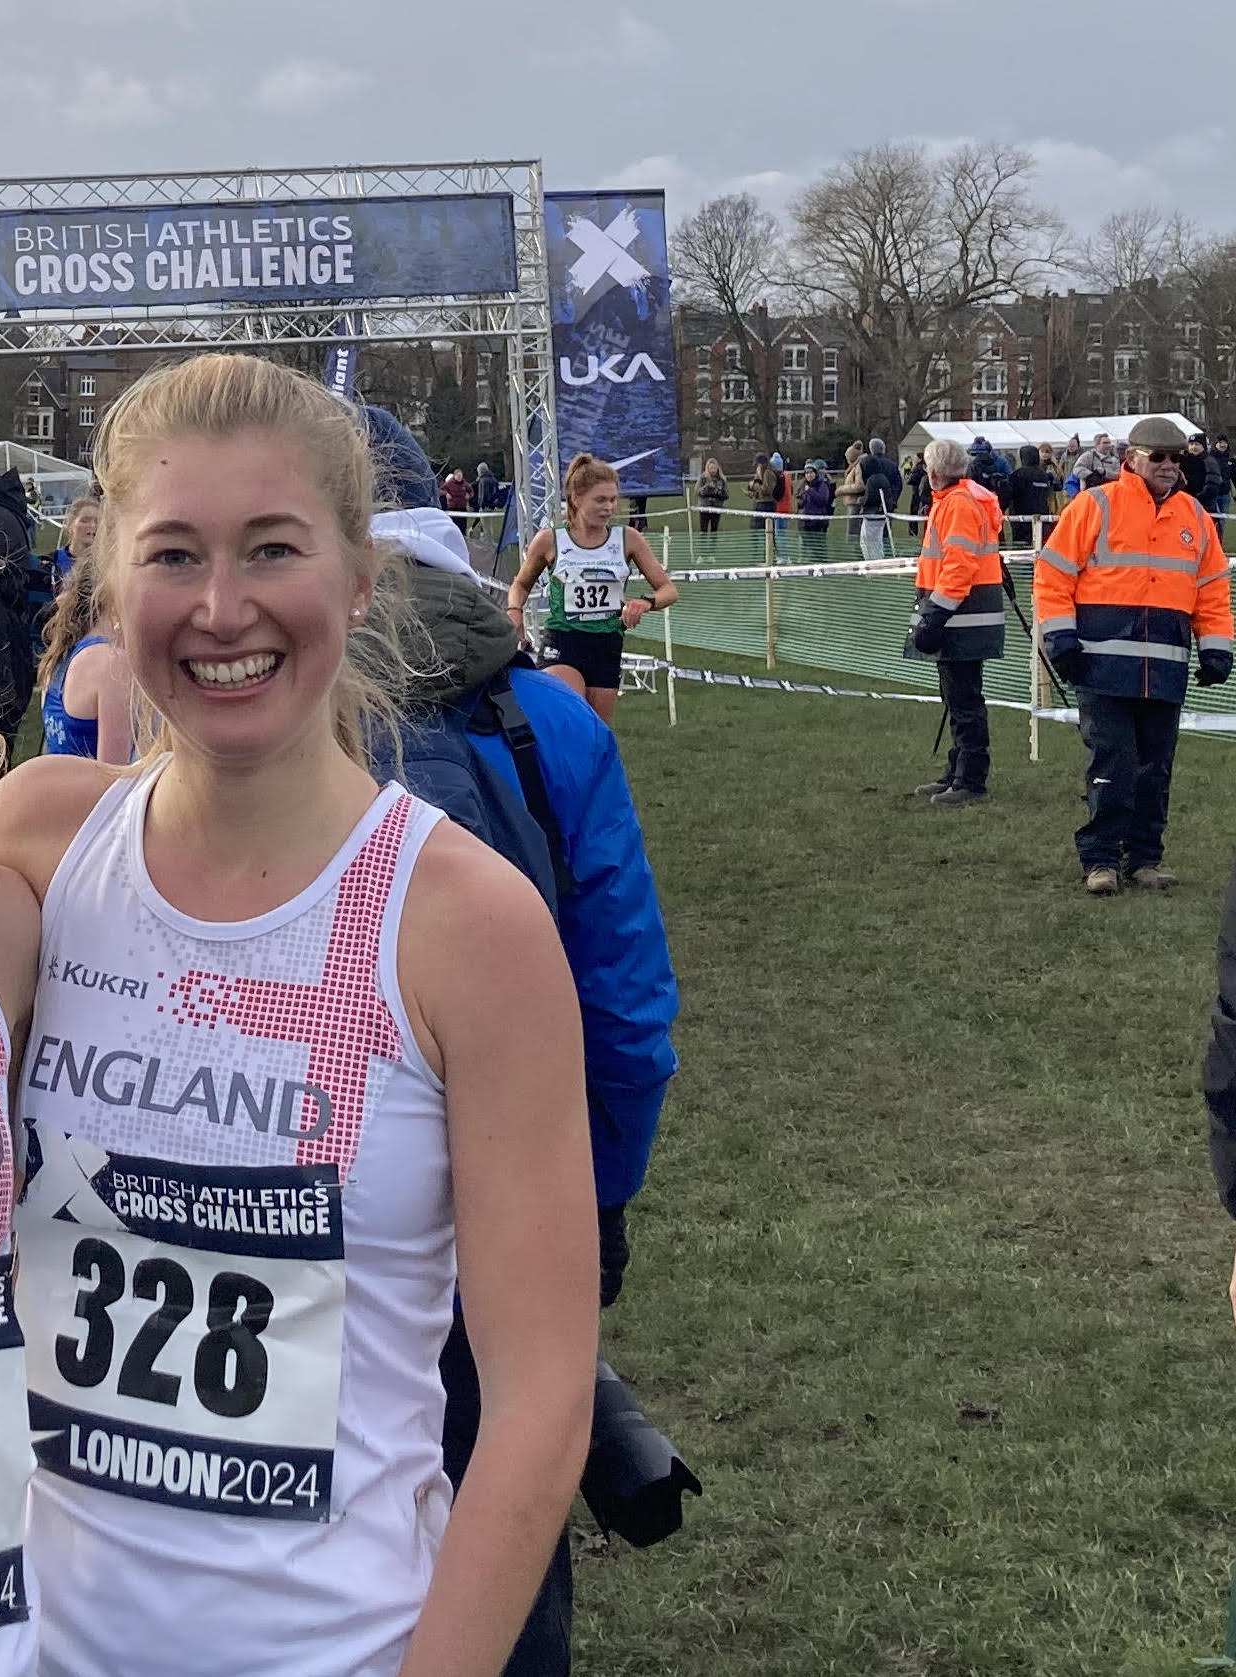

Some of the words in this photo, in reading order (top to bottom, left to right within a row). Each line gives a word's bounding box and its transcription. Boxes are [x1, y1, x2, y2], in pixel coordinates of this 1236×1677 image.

[14, 223, 150, 252] BRITISH
[156, 216, 353, 248] ATHLETICS
[15, 251, 135, 296] CROSS
[145, 244, 354, 291] CHALLENGE
[560, 352, 666, 386] UKA
[574, 585, 610, 609] 332
[61, 960, 150, 1000] KUKRI
[28, 1035, 333, 1142] ENGLAND
[114, 1190, 188, 1224] CROSS
[192, 1201, 331, 1236] CHALLENGE
[55, 1237, 275, 1418] 328
